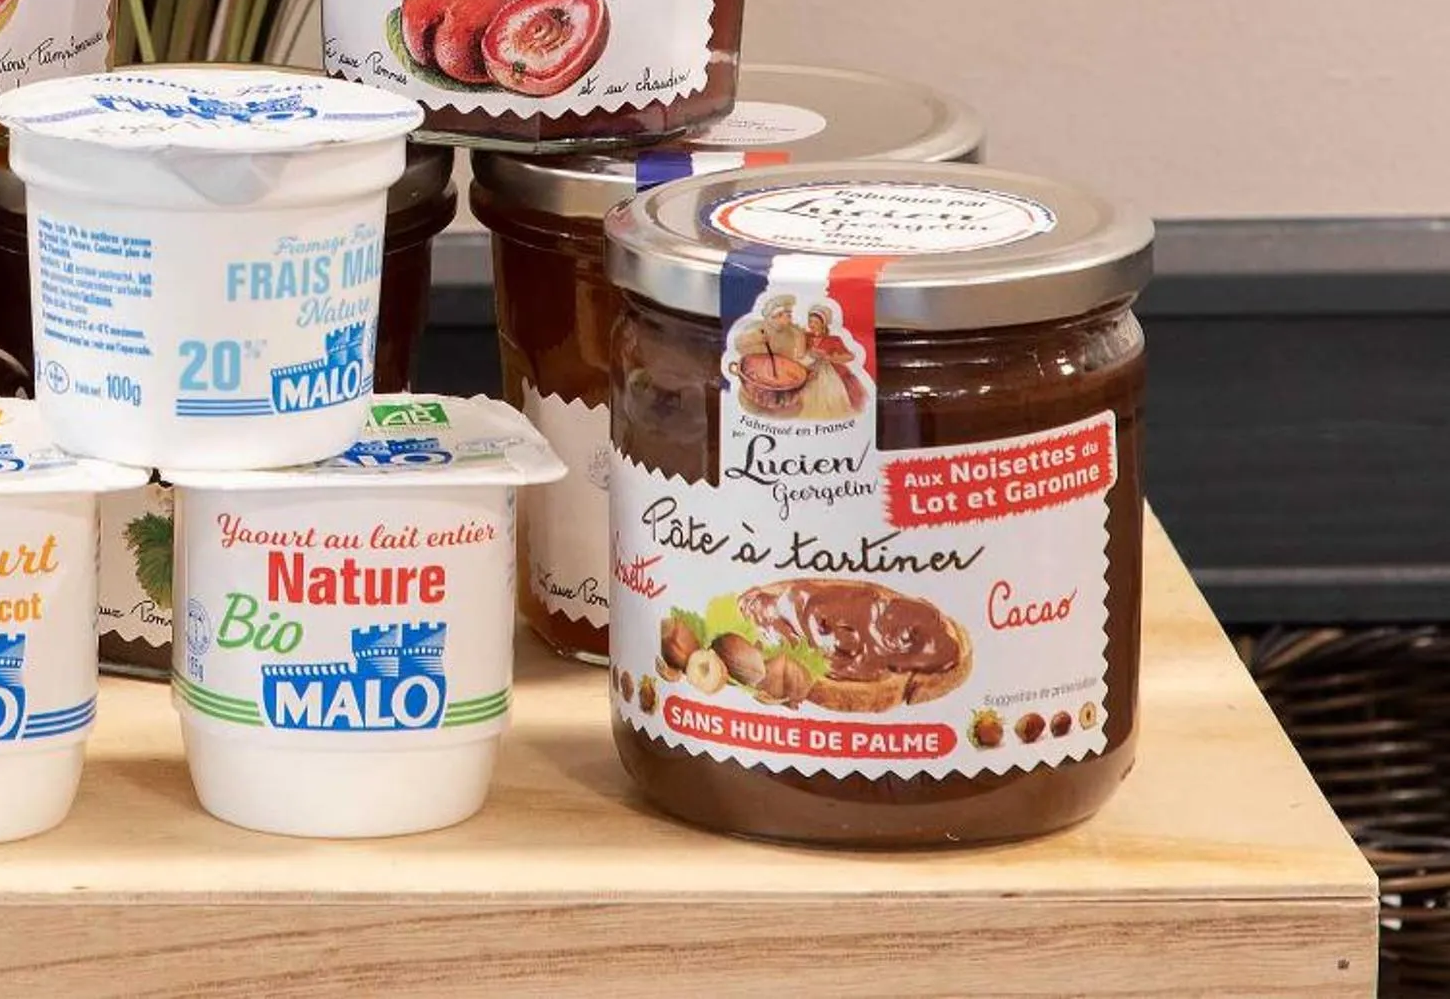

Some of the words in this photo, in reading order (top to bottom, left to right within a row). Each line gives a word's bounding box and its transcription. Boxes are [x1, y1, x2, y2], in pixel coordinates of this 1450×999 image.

[578, 74, 600, 97] et
[226, 256, 332, 303] FRAIS
[341, 242, 382, 290] MAL
[106, 372, 142, 407] 100g
[279, 360, 361, 412] MALO
[739, 414, 792, 437] Fabriqué
[796, 427, 811, 436] en
[814, 418, 855, 436] France
[725, 434, 871, 486] Lucien
[904, 472, 944, 488] Aux
[950, 443, 1076, 484] Noisettes
[772, 480, 878, 521] Georgelin
[910, 487, 958, 515] Lot
[967, 486, 997, 510] et
[1004, 464, 1101, 504] Garonne
[217, 513, 316, 548] Yaourt
[324, 533, 364, 549] au
[370, 523, 420, 549] lait
[427, 521, 498, 548] entier
[641, 497, 730, 555] Pâte
[731, 522, 771, 565] à
[774, 530, 984, 574] tartiner
[268, 551, 446, 606] Nature
[578, 577, 609, 608] Pom
[216, 592, 304, 654] Bio
[988, 580, 1078, 630] Cacao
[276, 675, 440, 728] MALO
[670, 706, 723, 736] SANS
[730, 720, 801, 748] HUILE
[809, 730, 842, 751] DE
[852, 733, 939, 753] PALME
